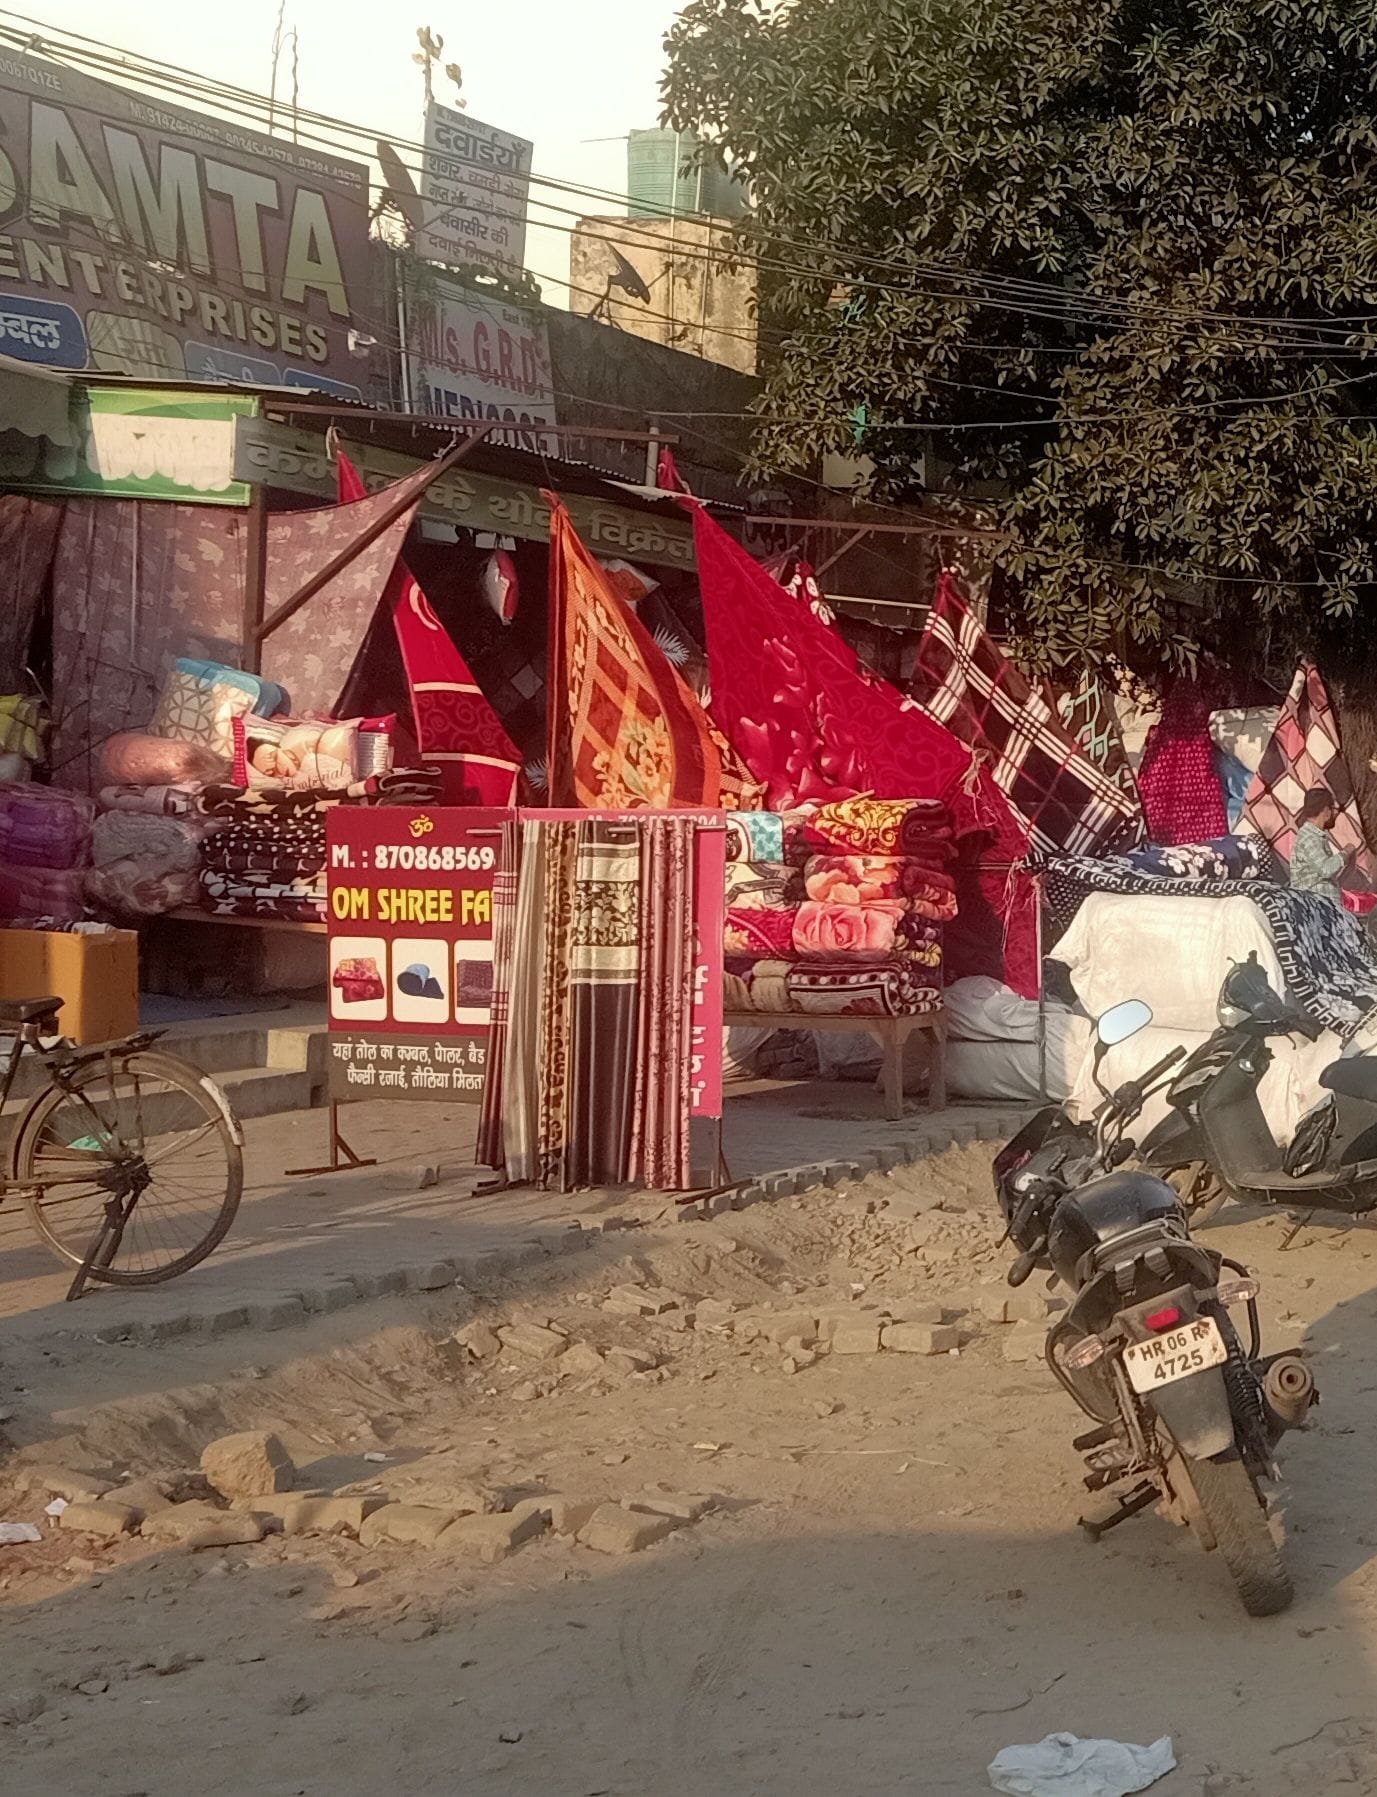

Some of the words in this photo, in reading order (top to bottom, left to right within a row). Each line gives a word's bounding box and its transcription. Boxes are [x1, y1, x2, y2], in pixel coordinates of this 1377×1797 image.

[0, 234, 329, 363] ENTERPRISES
[425, 477, 476, 519] के
[588, 511, 694, 560] विक्रेत
[375, 844, 495, 871] 870868569
[332, 886, 370, 921] OM
[377, 887, 454, 925] SHREE
[461, 889, 494, 926] FA
[332, 1036, 353, 1061] यहां
[355, 1038, 378, 1060] तोल
[379, 1044, 395, 1061] का
[411, 1065, 450, 1089] तौलिया
[452, 1067, 485, 1090] मिलत
[1140, 1341, 1166, 1362] HR
[1166, 1332, 1187, 1351] 06
[1154, 1348, 1204, 1380] 4725
